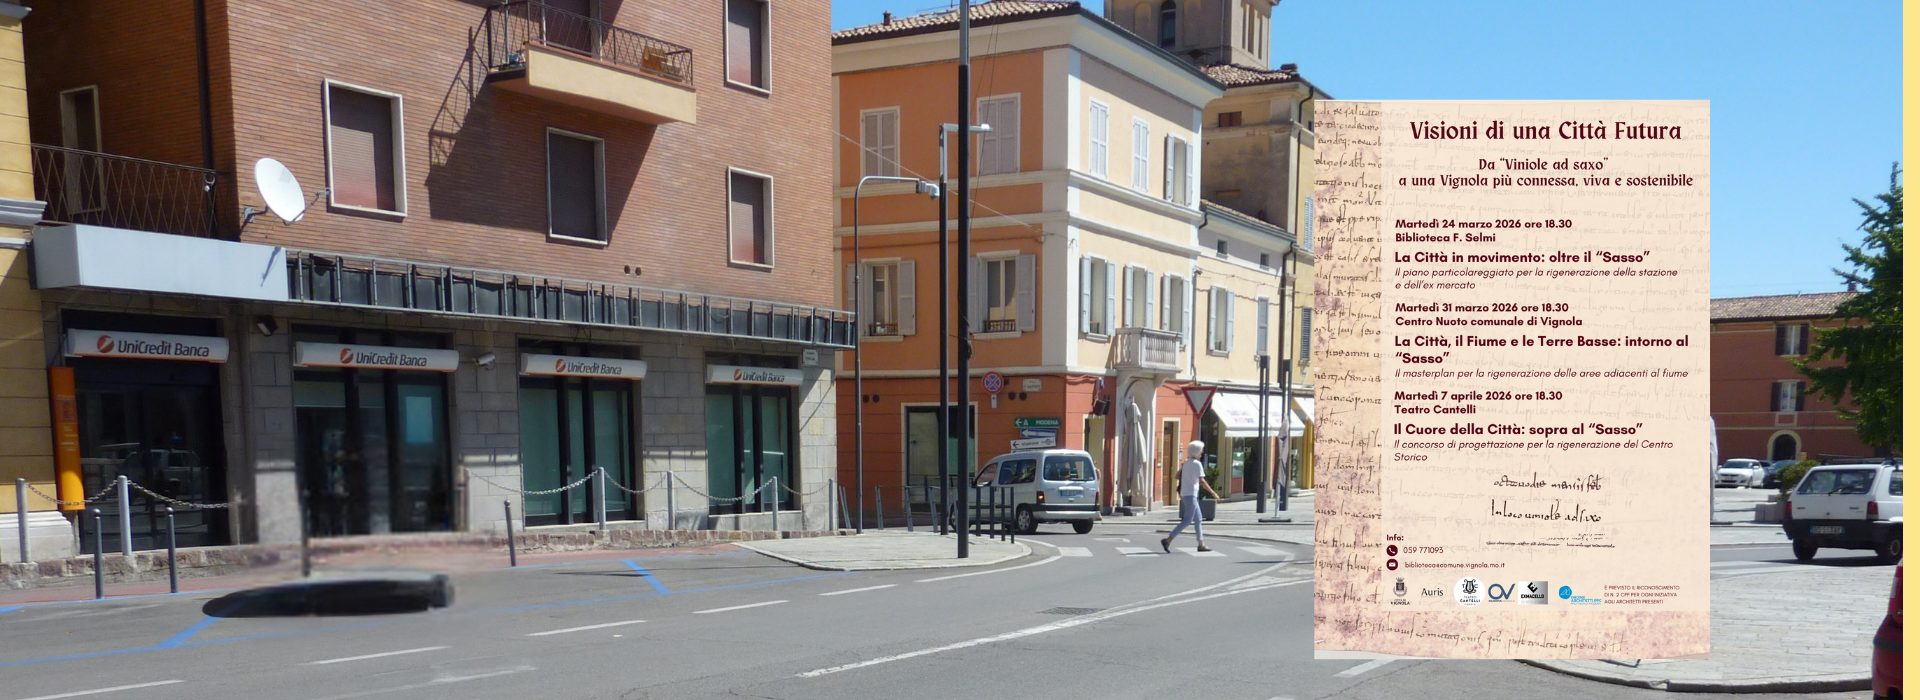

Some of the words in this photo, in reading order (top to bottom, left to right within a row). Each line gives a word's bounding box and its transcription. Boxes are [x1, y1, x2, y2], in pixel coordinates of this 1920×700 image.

[118, 339, 172, 355] UniCredit
[174, 343, 210, 357] Banca
[356, 351, 399, 365] UniCredit
[400, 354, 427, 366] Banca
[568, 361, 600, 374] UniCredit
[601, 364, 622, 375] Banca
